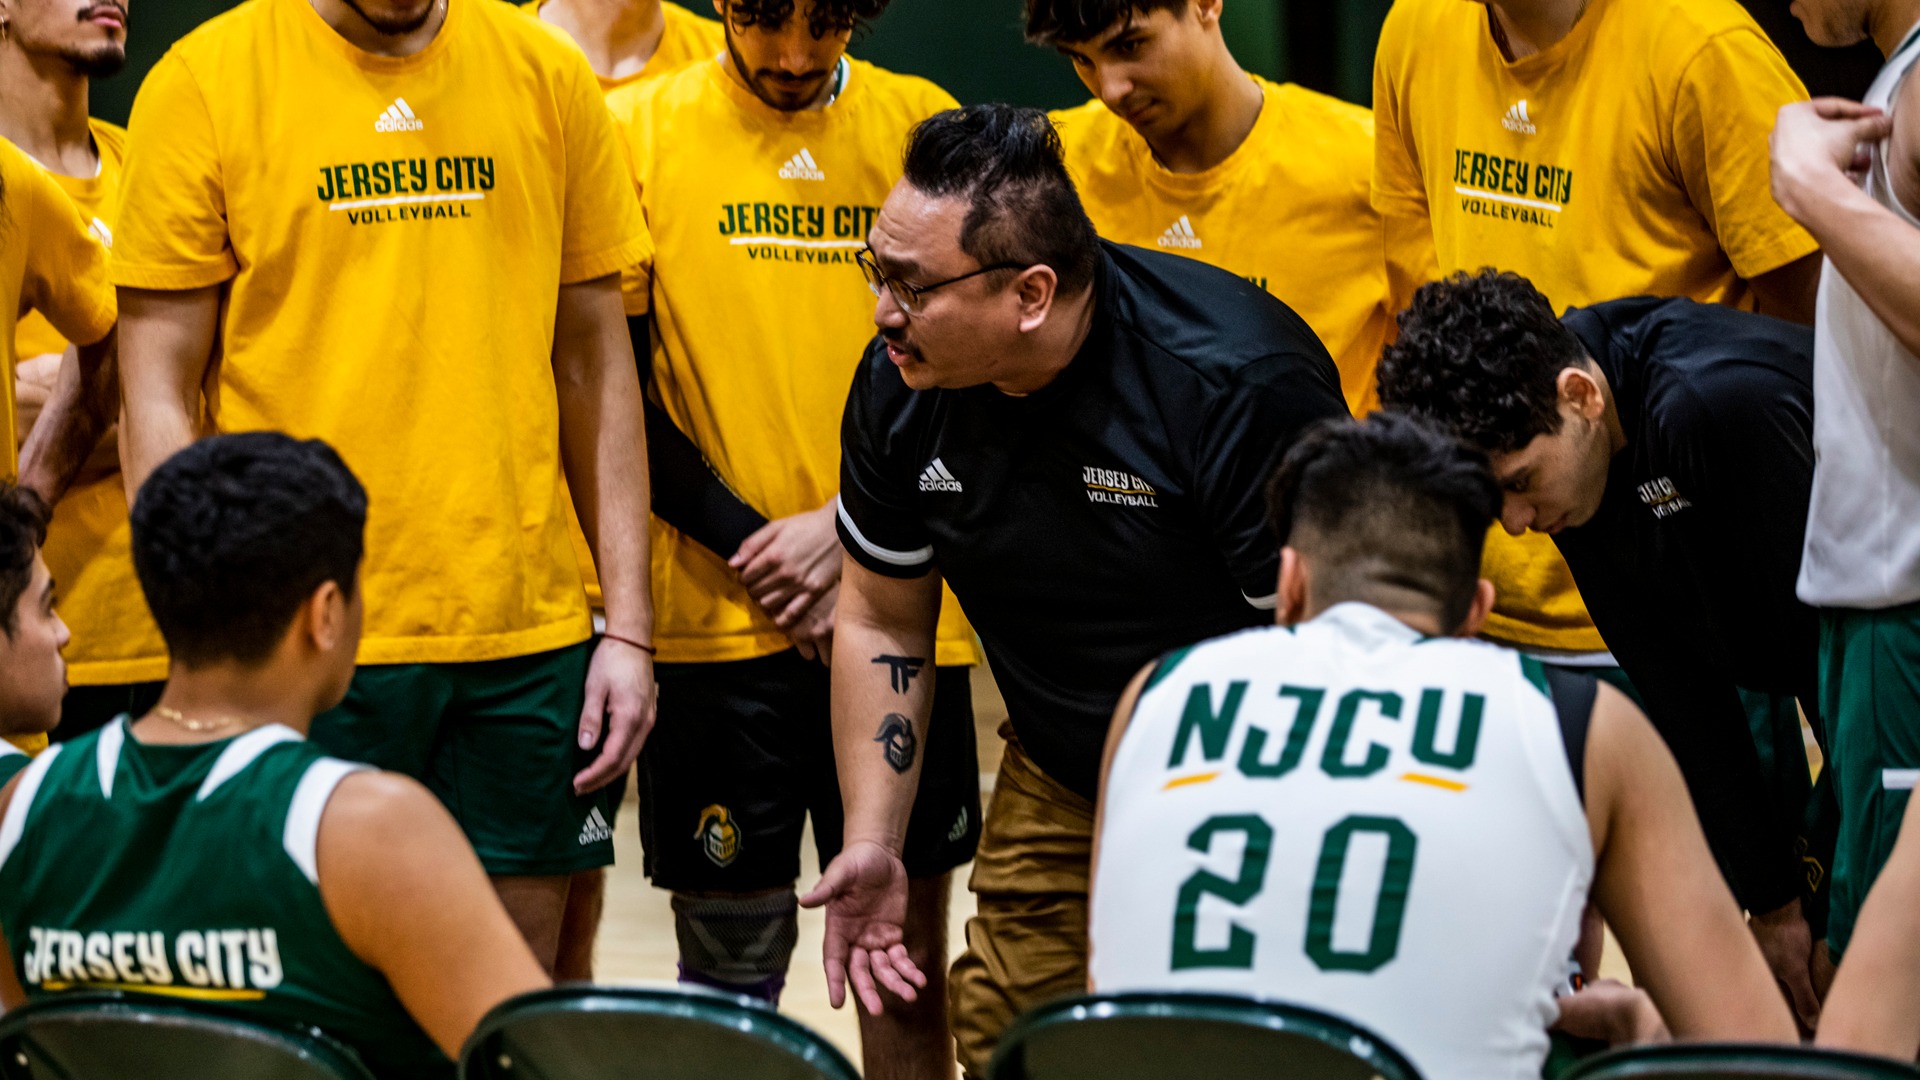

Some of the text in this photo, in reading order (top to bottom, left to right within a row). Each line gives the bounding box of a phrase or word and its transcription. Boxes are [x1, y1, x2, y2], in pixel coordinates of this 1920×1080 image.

[375, 118, 423, 133] adidas
[317, 156, 495, 202] JERSEY CITY
[778, 165, 825, 181] adidas
[1453, 148, 1573, 205] JERSEY CITY
[347, 203, 472, 226] VOLLEYBALL
[718, 202, 881, 239] JERSEY CIT
[1461, 198, 1554, 229] VOLLEYBALL
[1157, 235, 1202, 249] adidas
[747, 246, 857, 265] VOLLEYBAL
[918, 479, 963, 493] adidas
[1082, 465, 1129, 490] JERSEY
[1086, 489, 1159, 508] VOLLEYBALL
[1166, 680, 1486, 779] NJCU
[1170, 813, 1418, 976] 20
[24, 926, 284, 989] JERSEY CITY
